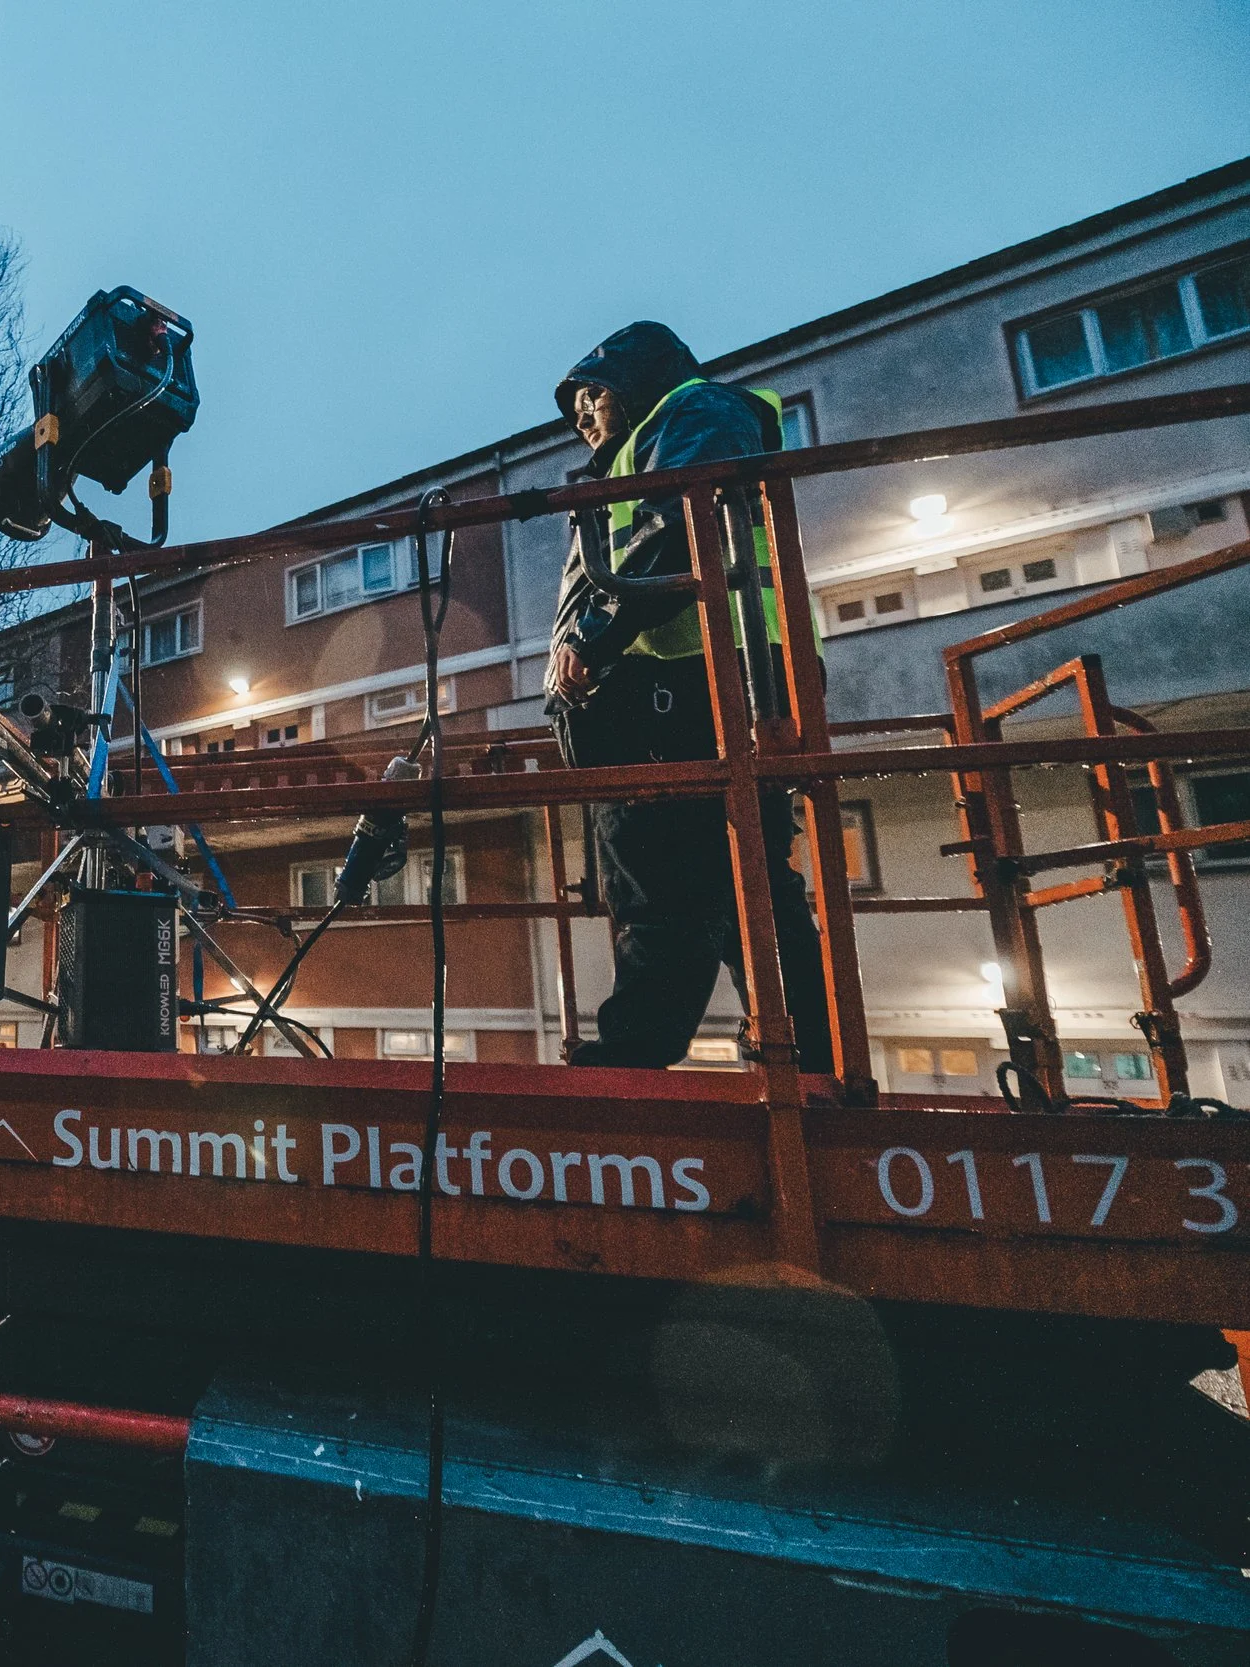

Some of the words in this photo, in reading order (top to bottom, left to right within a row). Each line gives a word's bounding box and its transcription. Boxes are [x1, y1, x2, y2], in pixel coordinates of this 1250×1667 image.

[158, 919, 171, 965] MG6K
[160, 974, 170, 1036] KNOWLED
[52, 1109, 298, 1184] Summit
[321, 1123, 711, 1212] Platforms
[877, 1146, 1130, 1227] 0117
[1173, 1157, 1239, 1234] 3
